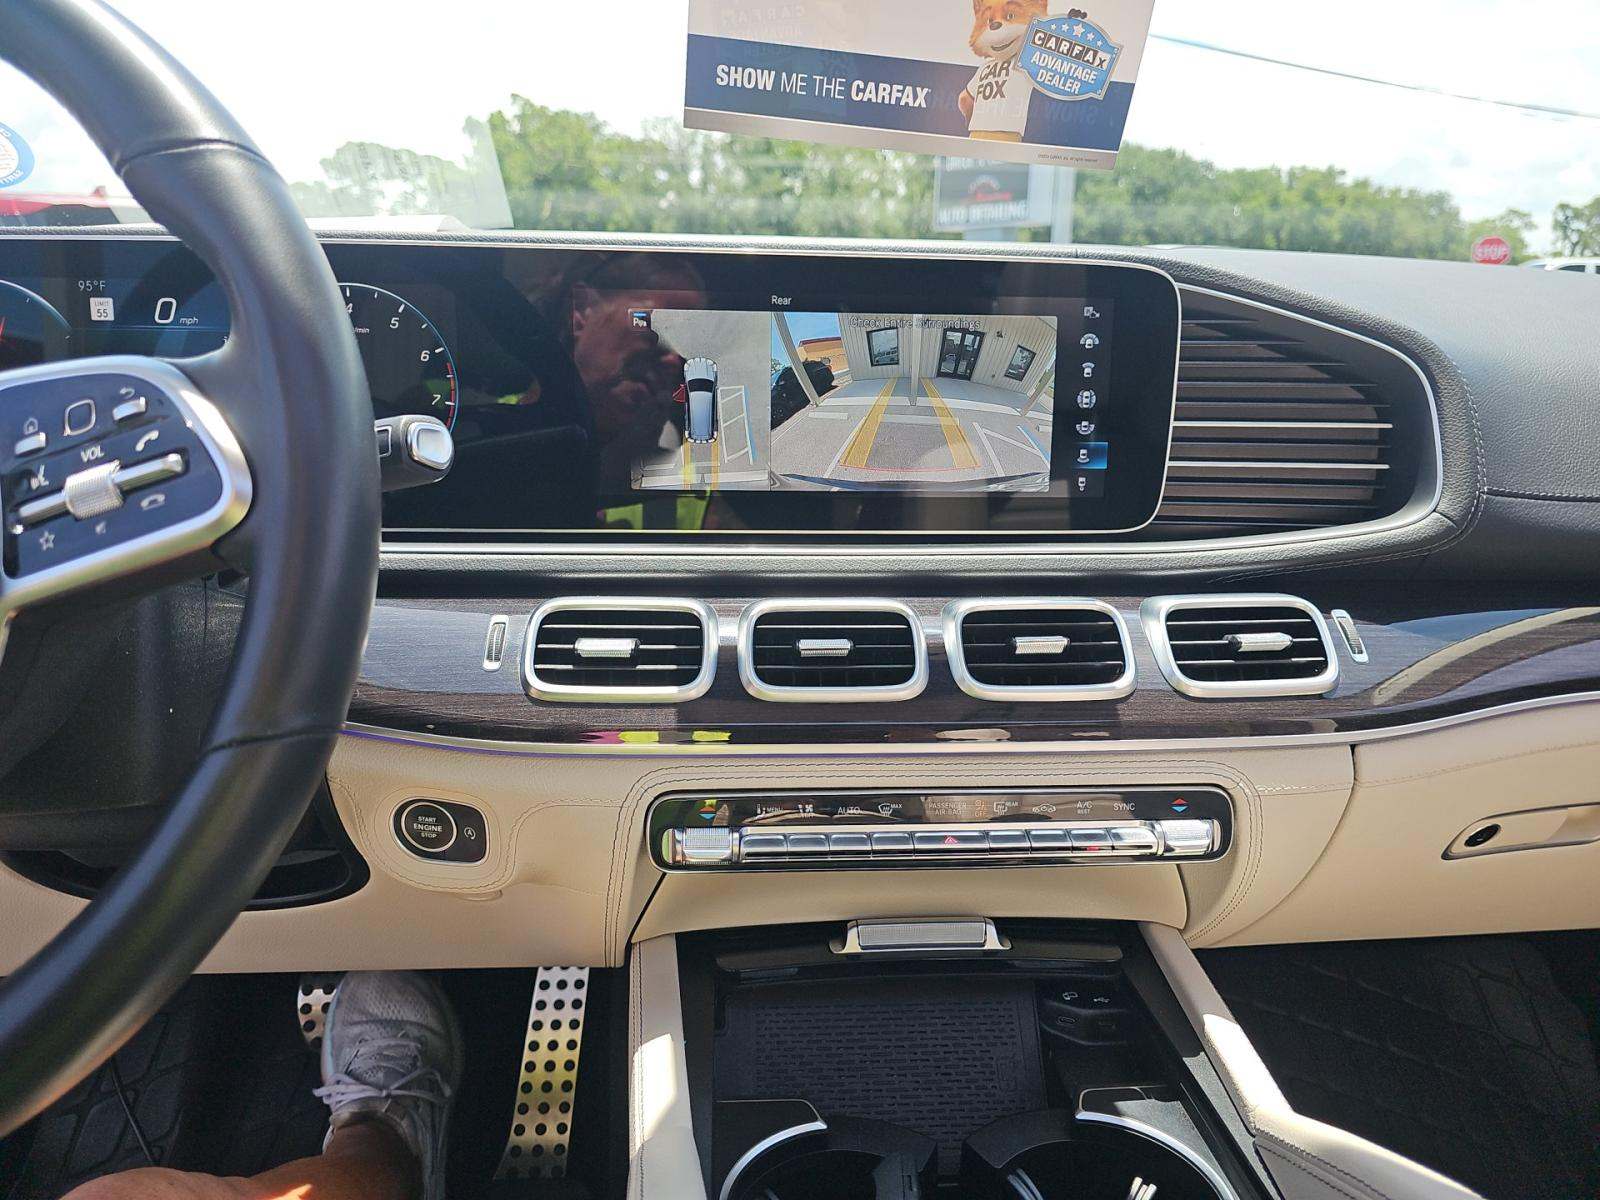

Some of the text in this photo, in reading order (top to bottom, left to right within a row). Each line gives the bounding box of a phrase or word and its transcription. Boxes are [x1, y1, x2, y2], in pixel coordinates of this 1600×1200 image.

[1033, 32, 1107, 68] CARFAX
[979, 60, 1011, 83] CAR
[1031, 51, 1098, 84] ADVANTAGE
[716, 64, 929, 108] SHOW ME THE CARFAX
[1036, 69, 1082, 95] DEALER
[976, 79, 1007, 101] FOX
[78, 280, 106, 292] 95°F
[771, 295, 792, 305] Rear
[96, 309, 109, 318] 55
[154, 297, 199, 325] 0 mph
[389, 317, 399, 329] 5
[850, 316, 880, 328] Check
[420, 350, 430, 361] 6
[431, 394, 441, 405] 7
[81, 445, 104, 462] VOL
[838, 806, 860, 814] AUTO
[1077, 801, 1093, 809] A/C
[1113, 803, 1135, 811] SYNC
[413, 823, 443, 832] ENGINE
